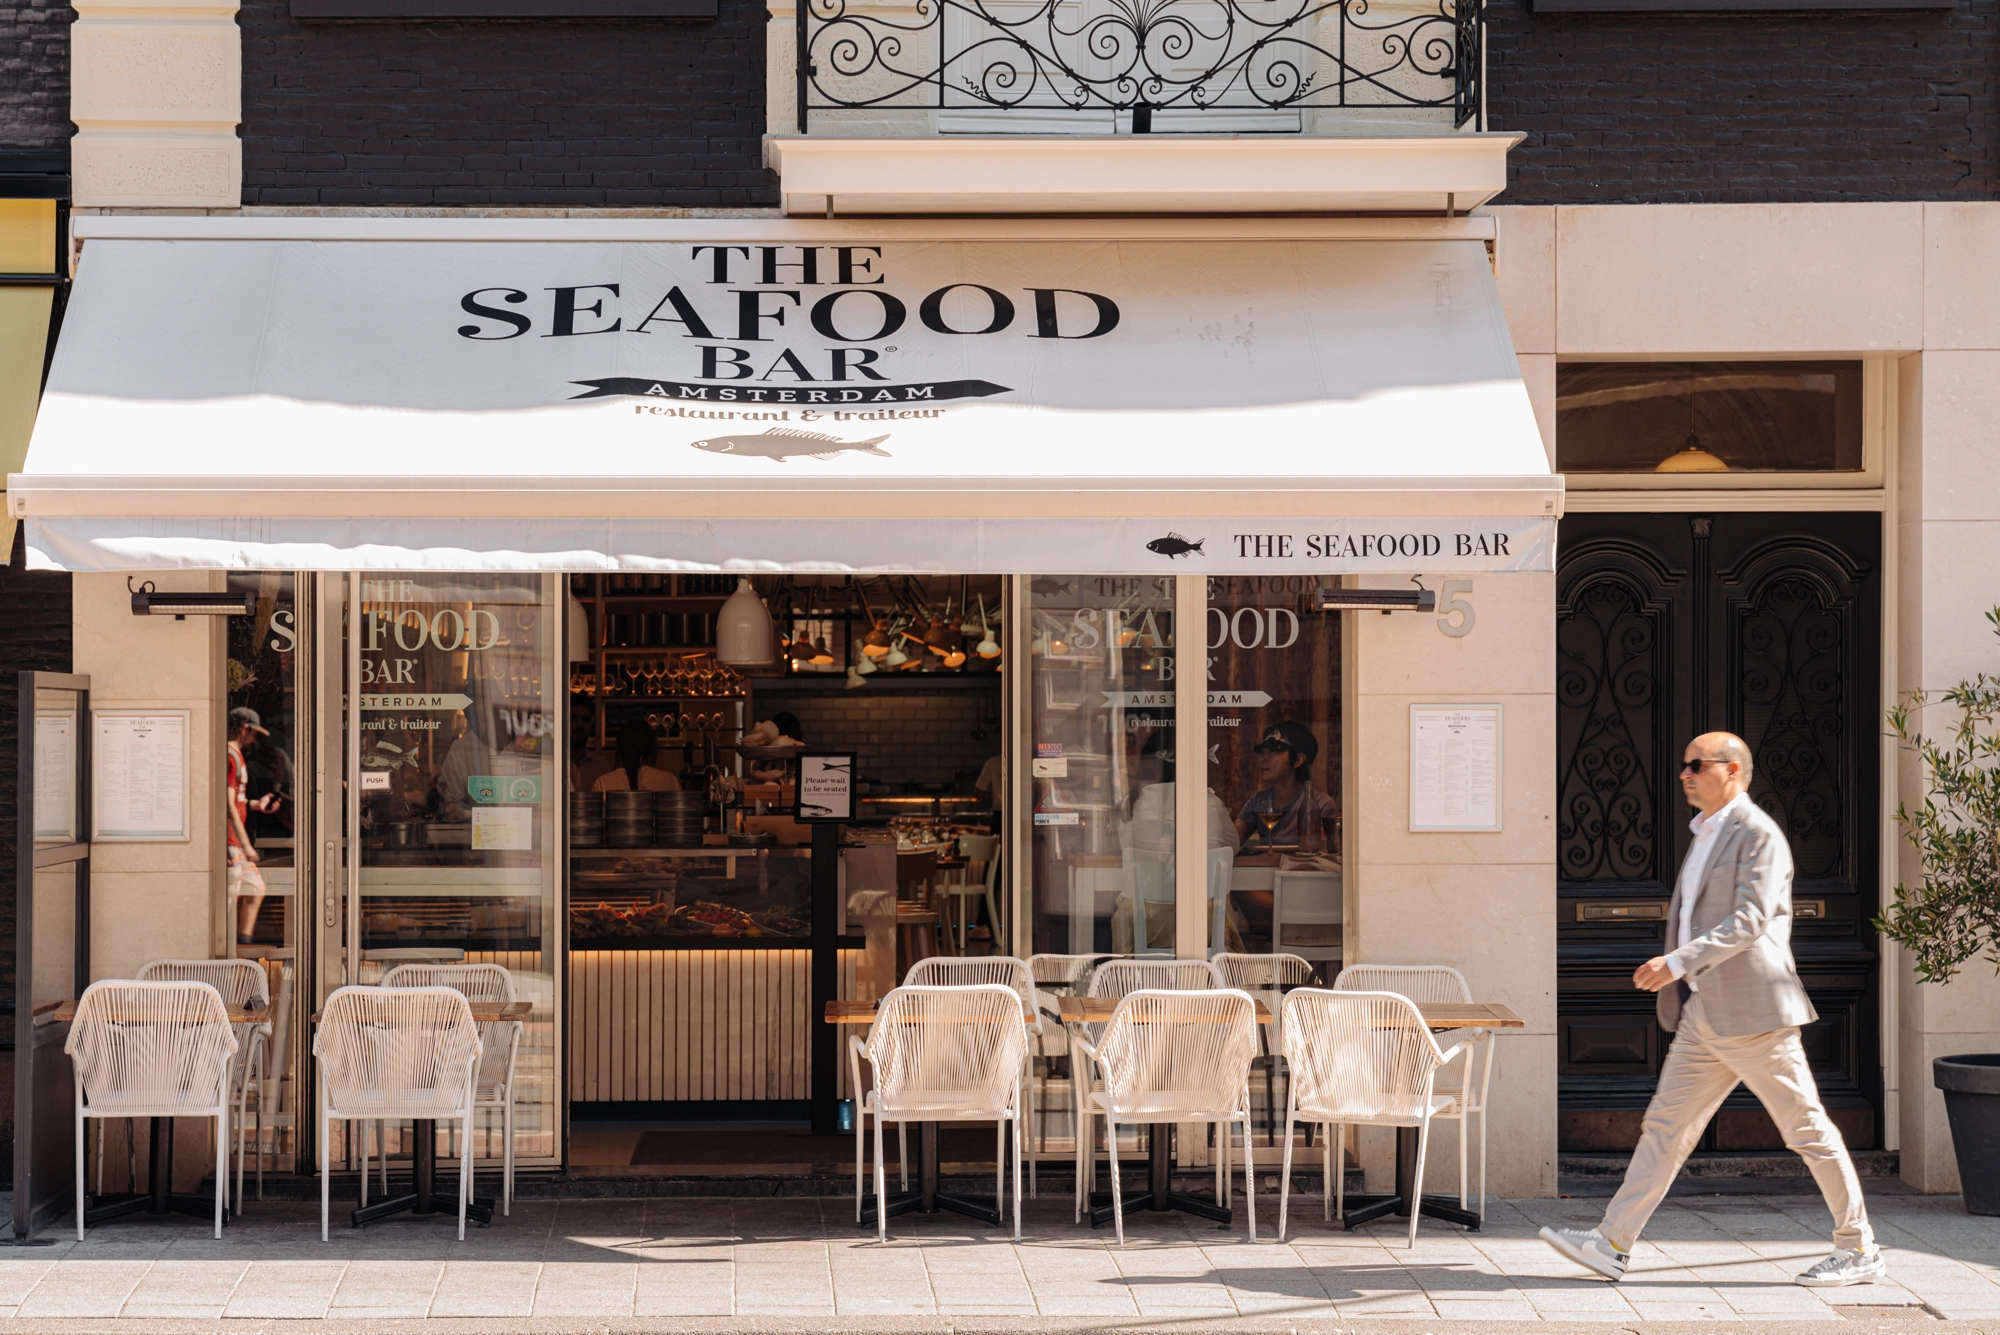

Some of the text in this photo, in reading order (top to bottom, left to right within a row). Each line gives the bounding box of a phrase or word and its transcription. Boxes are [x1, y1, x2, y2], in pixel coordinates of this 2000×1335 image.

[692, 246, 884, 285] THE
[457, 283, 1121, 342] SEAFOOD
[643, 382, 936, 403] AMSTERDAM
[635, 403, 946, 422] restaurant & traiteur
[1234, 532, 1511, 558] THE SEAFOOD BAR
[361, 579, 414, 602] THE
[1437, 580, 1476, 638] 5
[1074, 607, 1299, 649] SEAOOD
[1131, 694, 1242, 704] AMSDAM
[388, 718, 397, 730] &
[401, 718, 441, 730] traiteur
